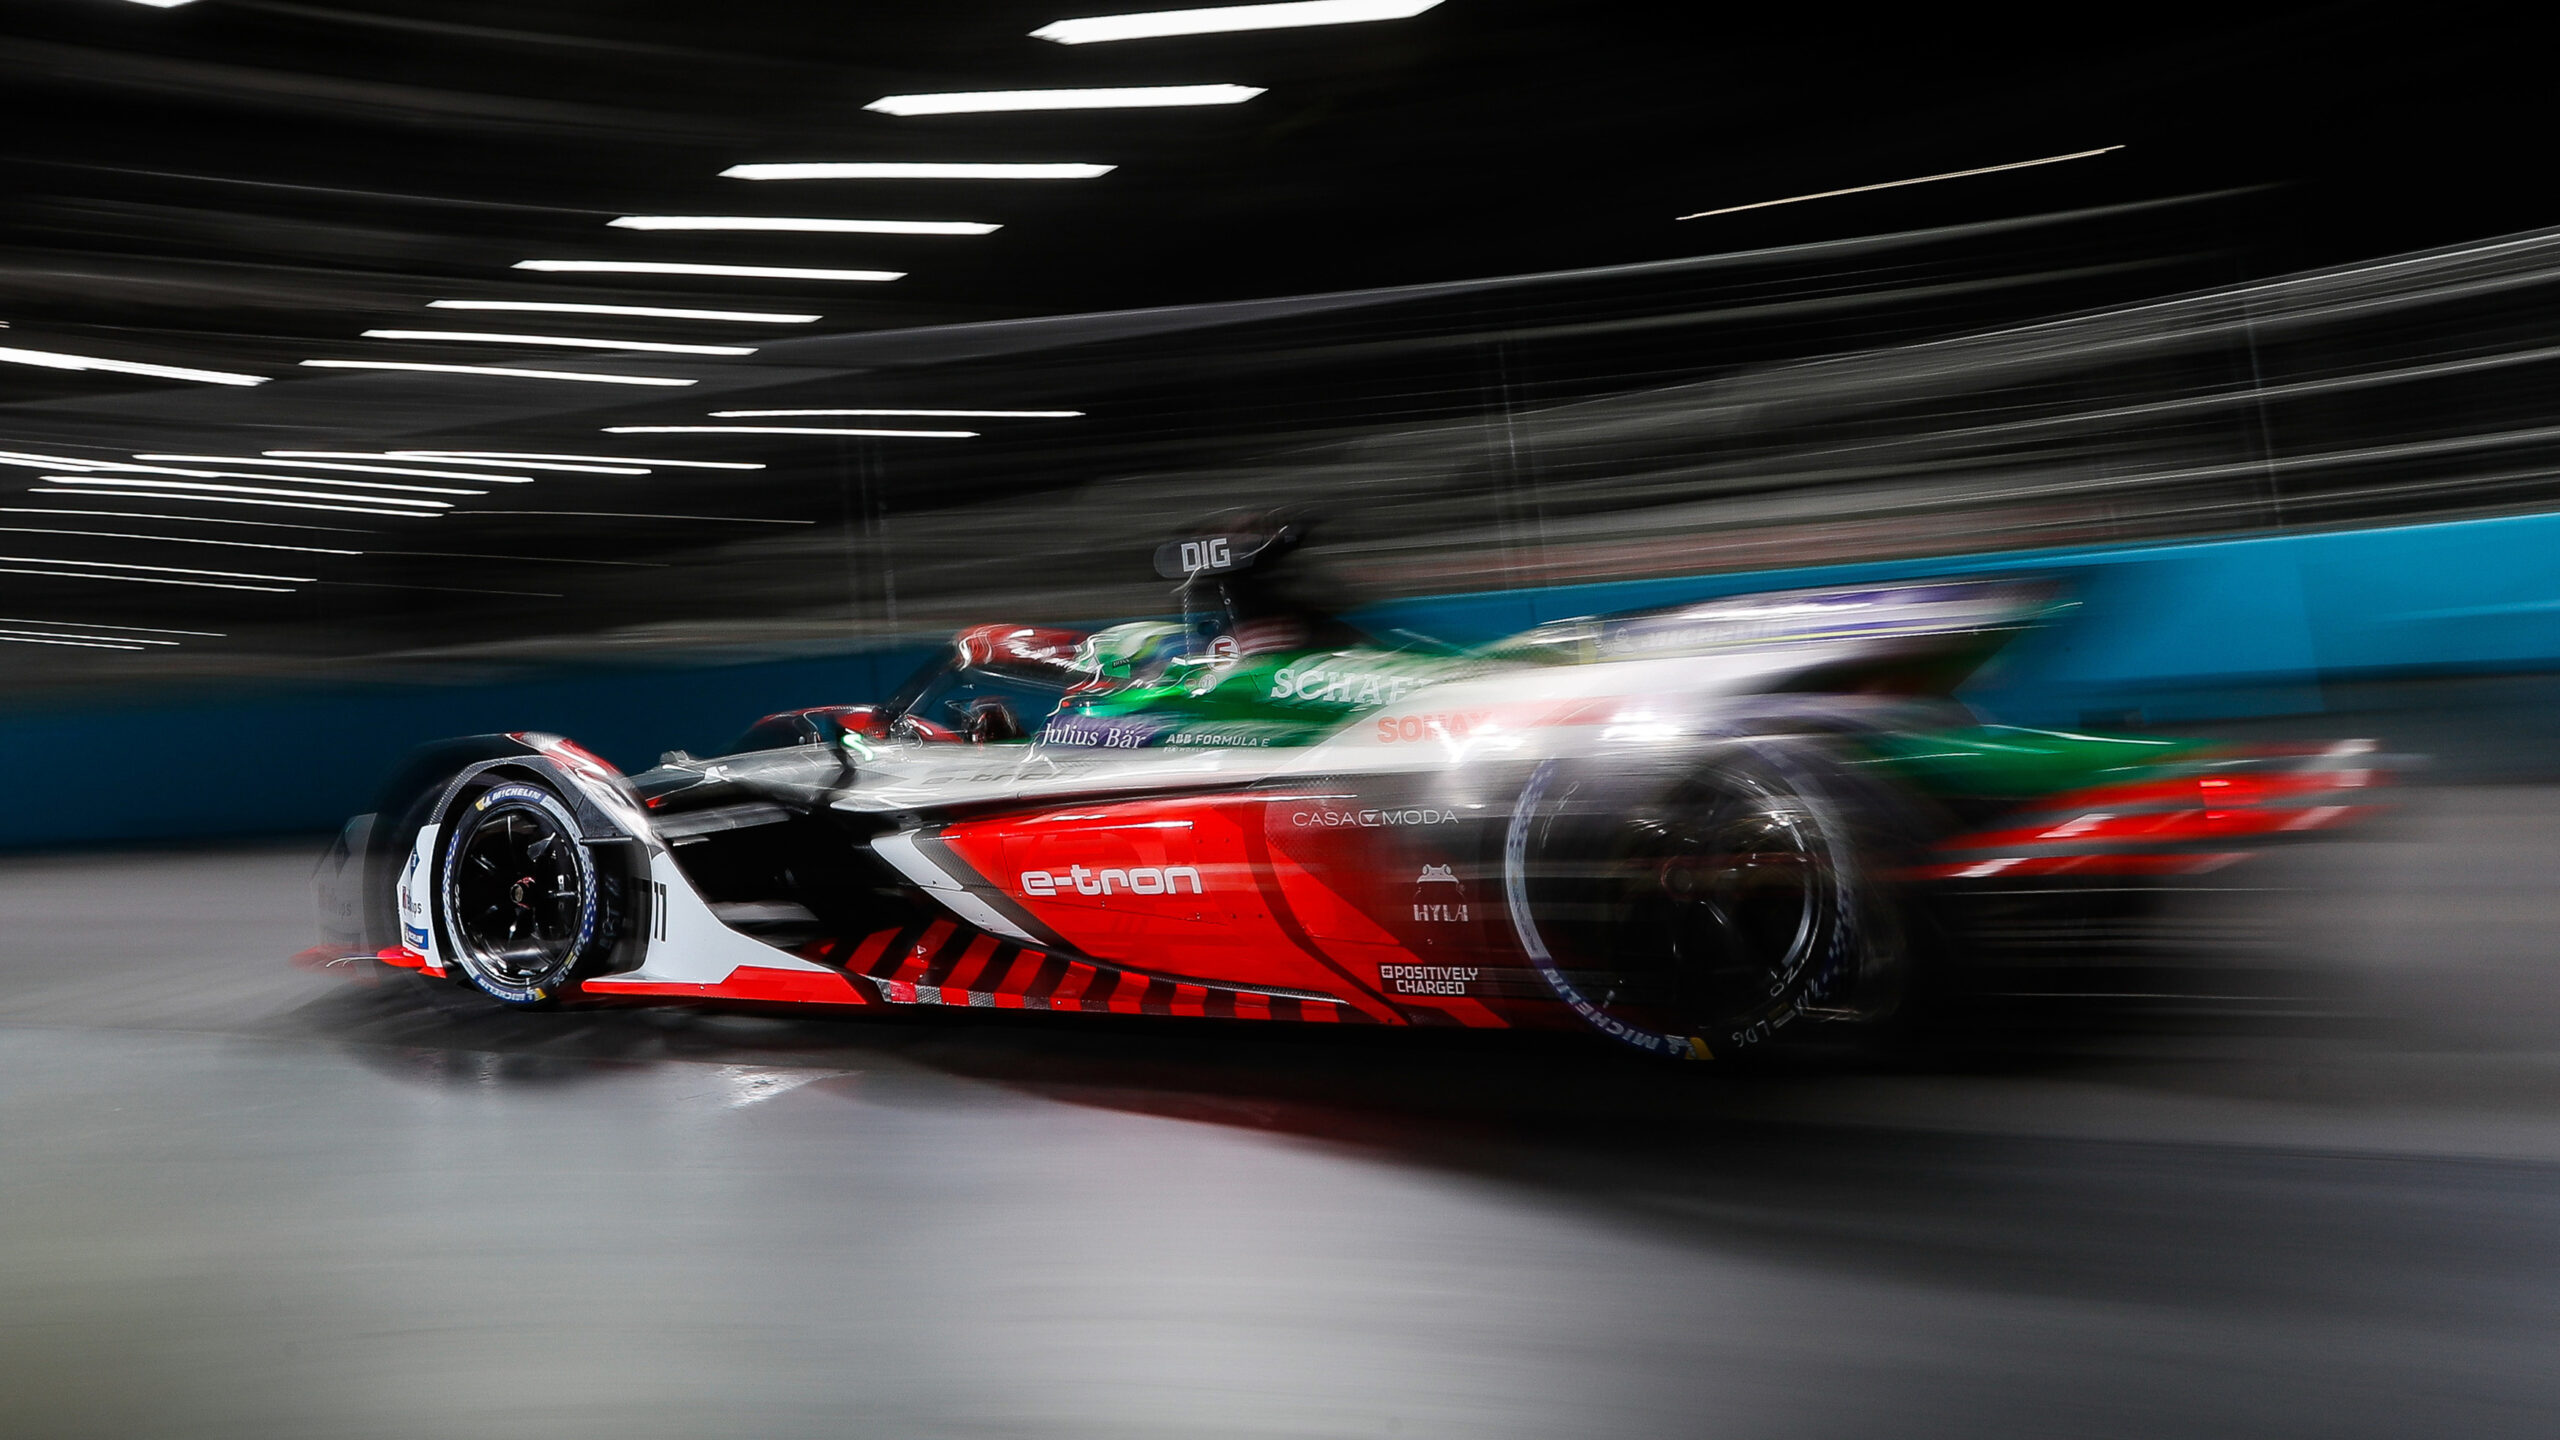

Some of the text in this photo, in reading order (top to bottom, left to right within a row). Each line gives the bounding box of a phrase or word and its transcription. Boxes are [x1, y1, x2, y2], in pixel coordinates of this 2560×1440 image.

[1181, 538, 1231, 572] DIG
[1040, 722, 1147, 749] Julius Bär
[1165, 733, 1271, 747] ABB FORMULA E
[492, 787, 542, 801] MICHELIN
[1020, 864, 1203, 896] e-tron
[653, 880, 667, 942] 11
[1413, 904, 1469, 922] HYLA
[1396, 980, 1466, 995] CHARGED
[1541, 967, 1661, 1050] MICHELIN
